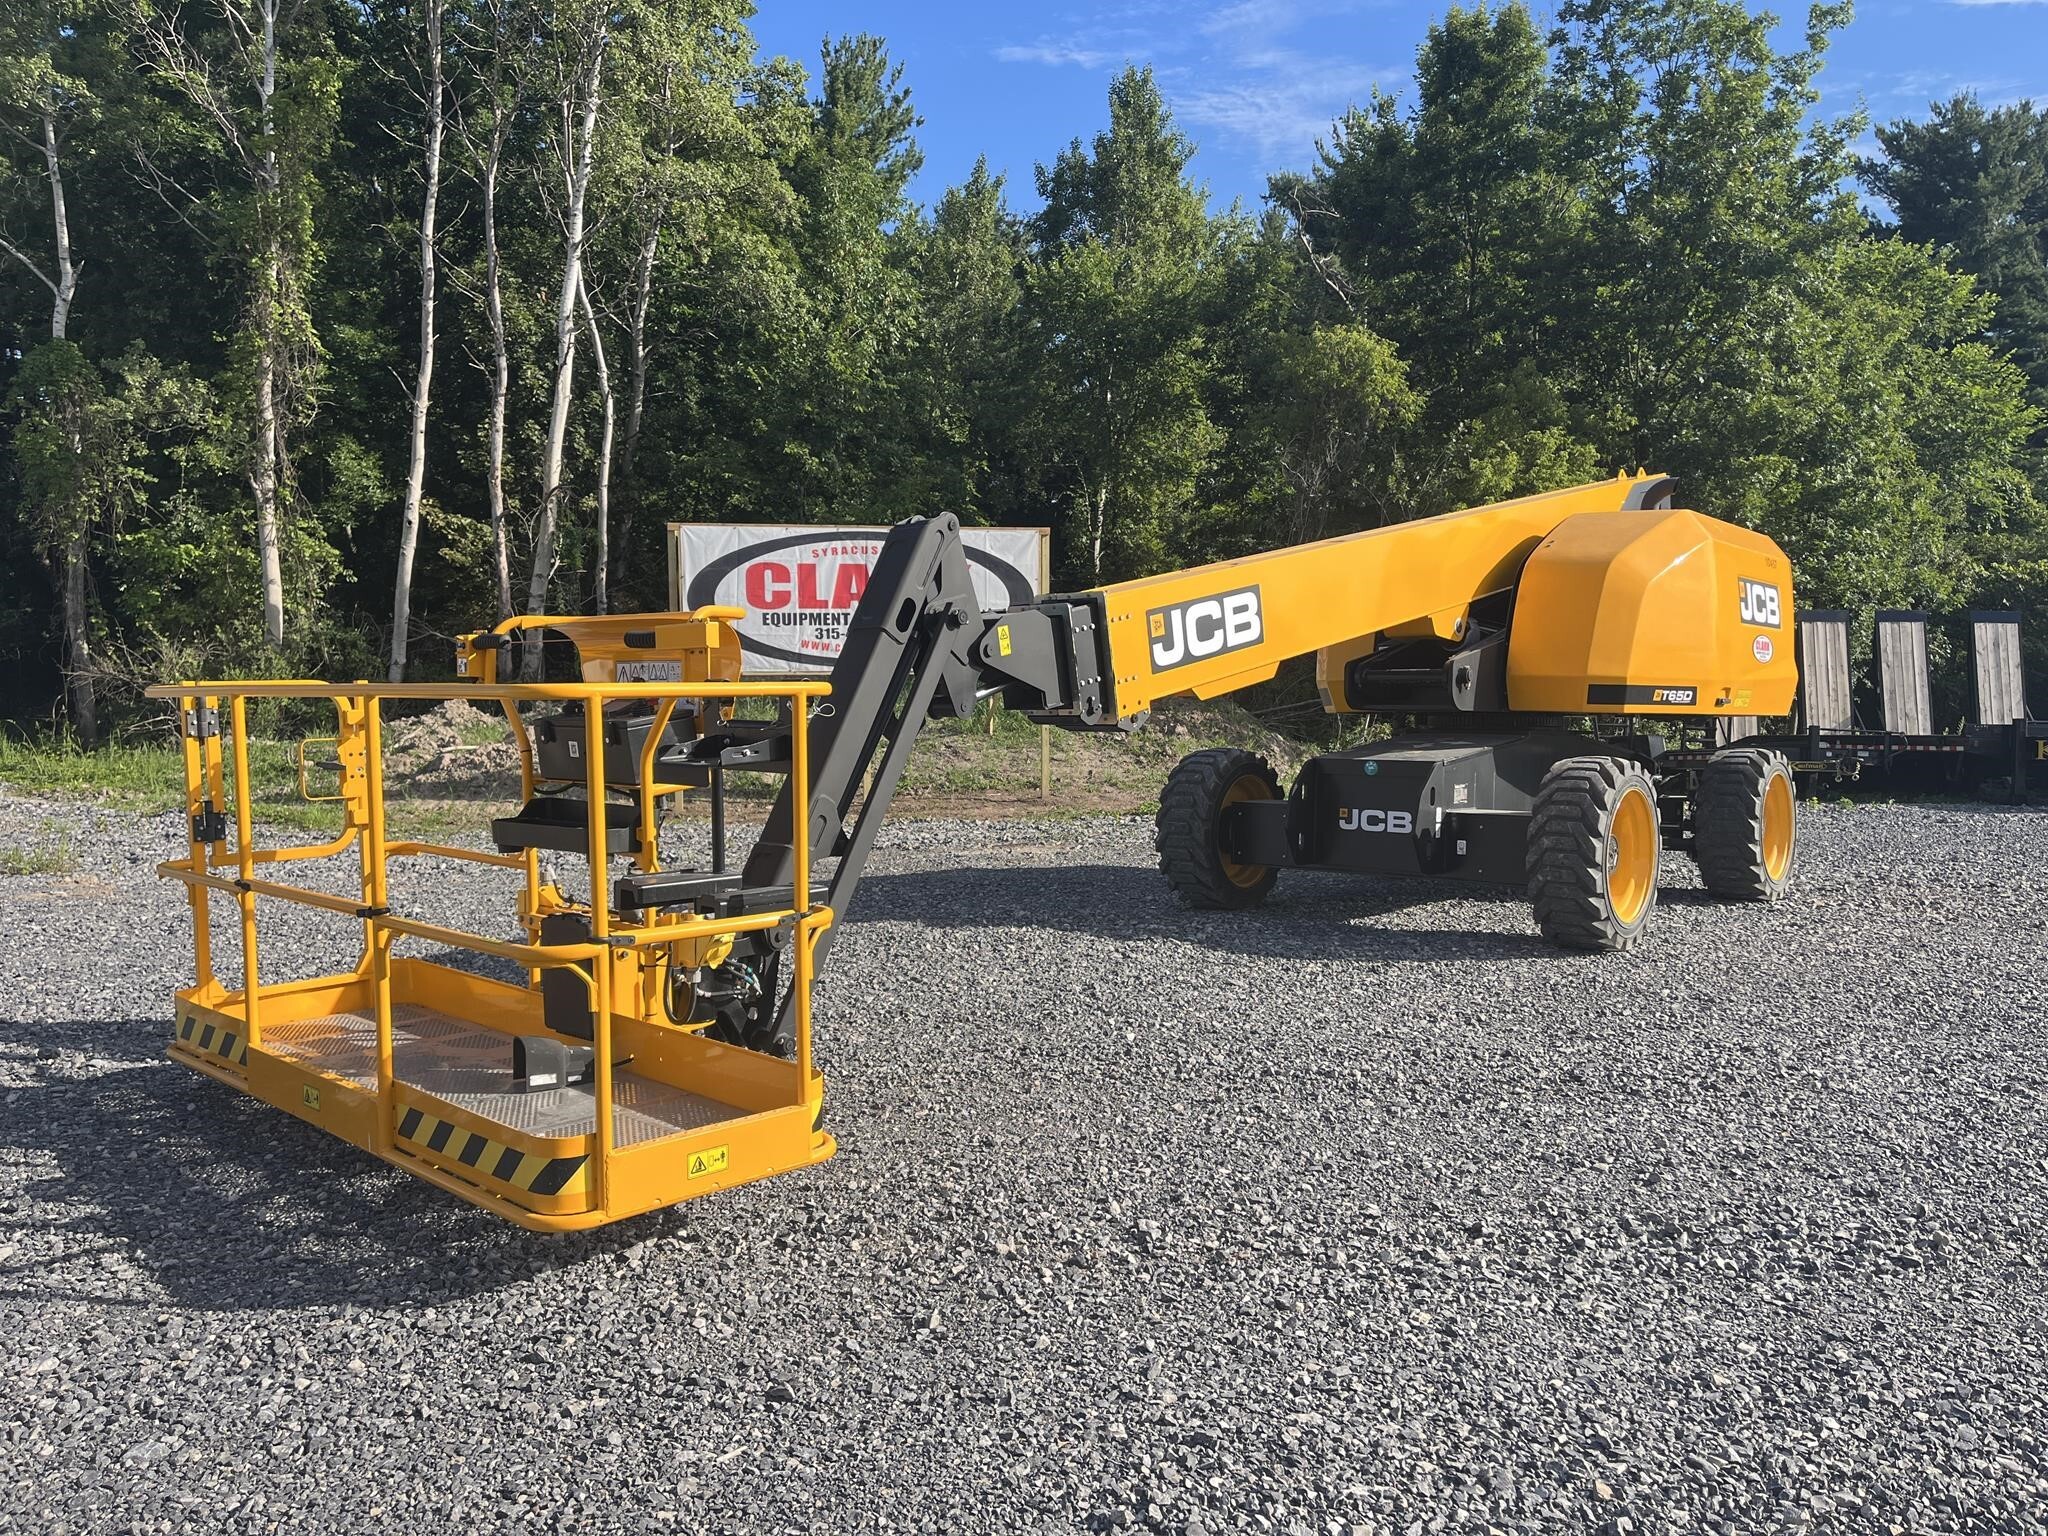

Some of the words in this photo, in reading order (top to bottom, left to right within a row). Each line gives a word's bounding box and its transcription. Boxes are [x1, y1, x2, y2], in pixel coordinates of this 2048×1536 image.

[812, 545, 879, 558] SYRACUS
[745, 562, 870, 610] CLA
[1740, 582, 1780, 625] JCB
[762, 612, 851, 627] EQUIPMENT
[1151, 591, 1261, 667] JCB
[815, 627, 847, 640] 315-
[1662, 690, 1693, 701] T65D
[1339, 808, 1413, 834] JCB
